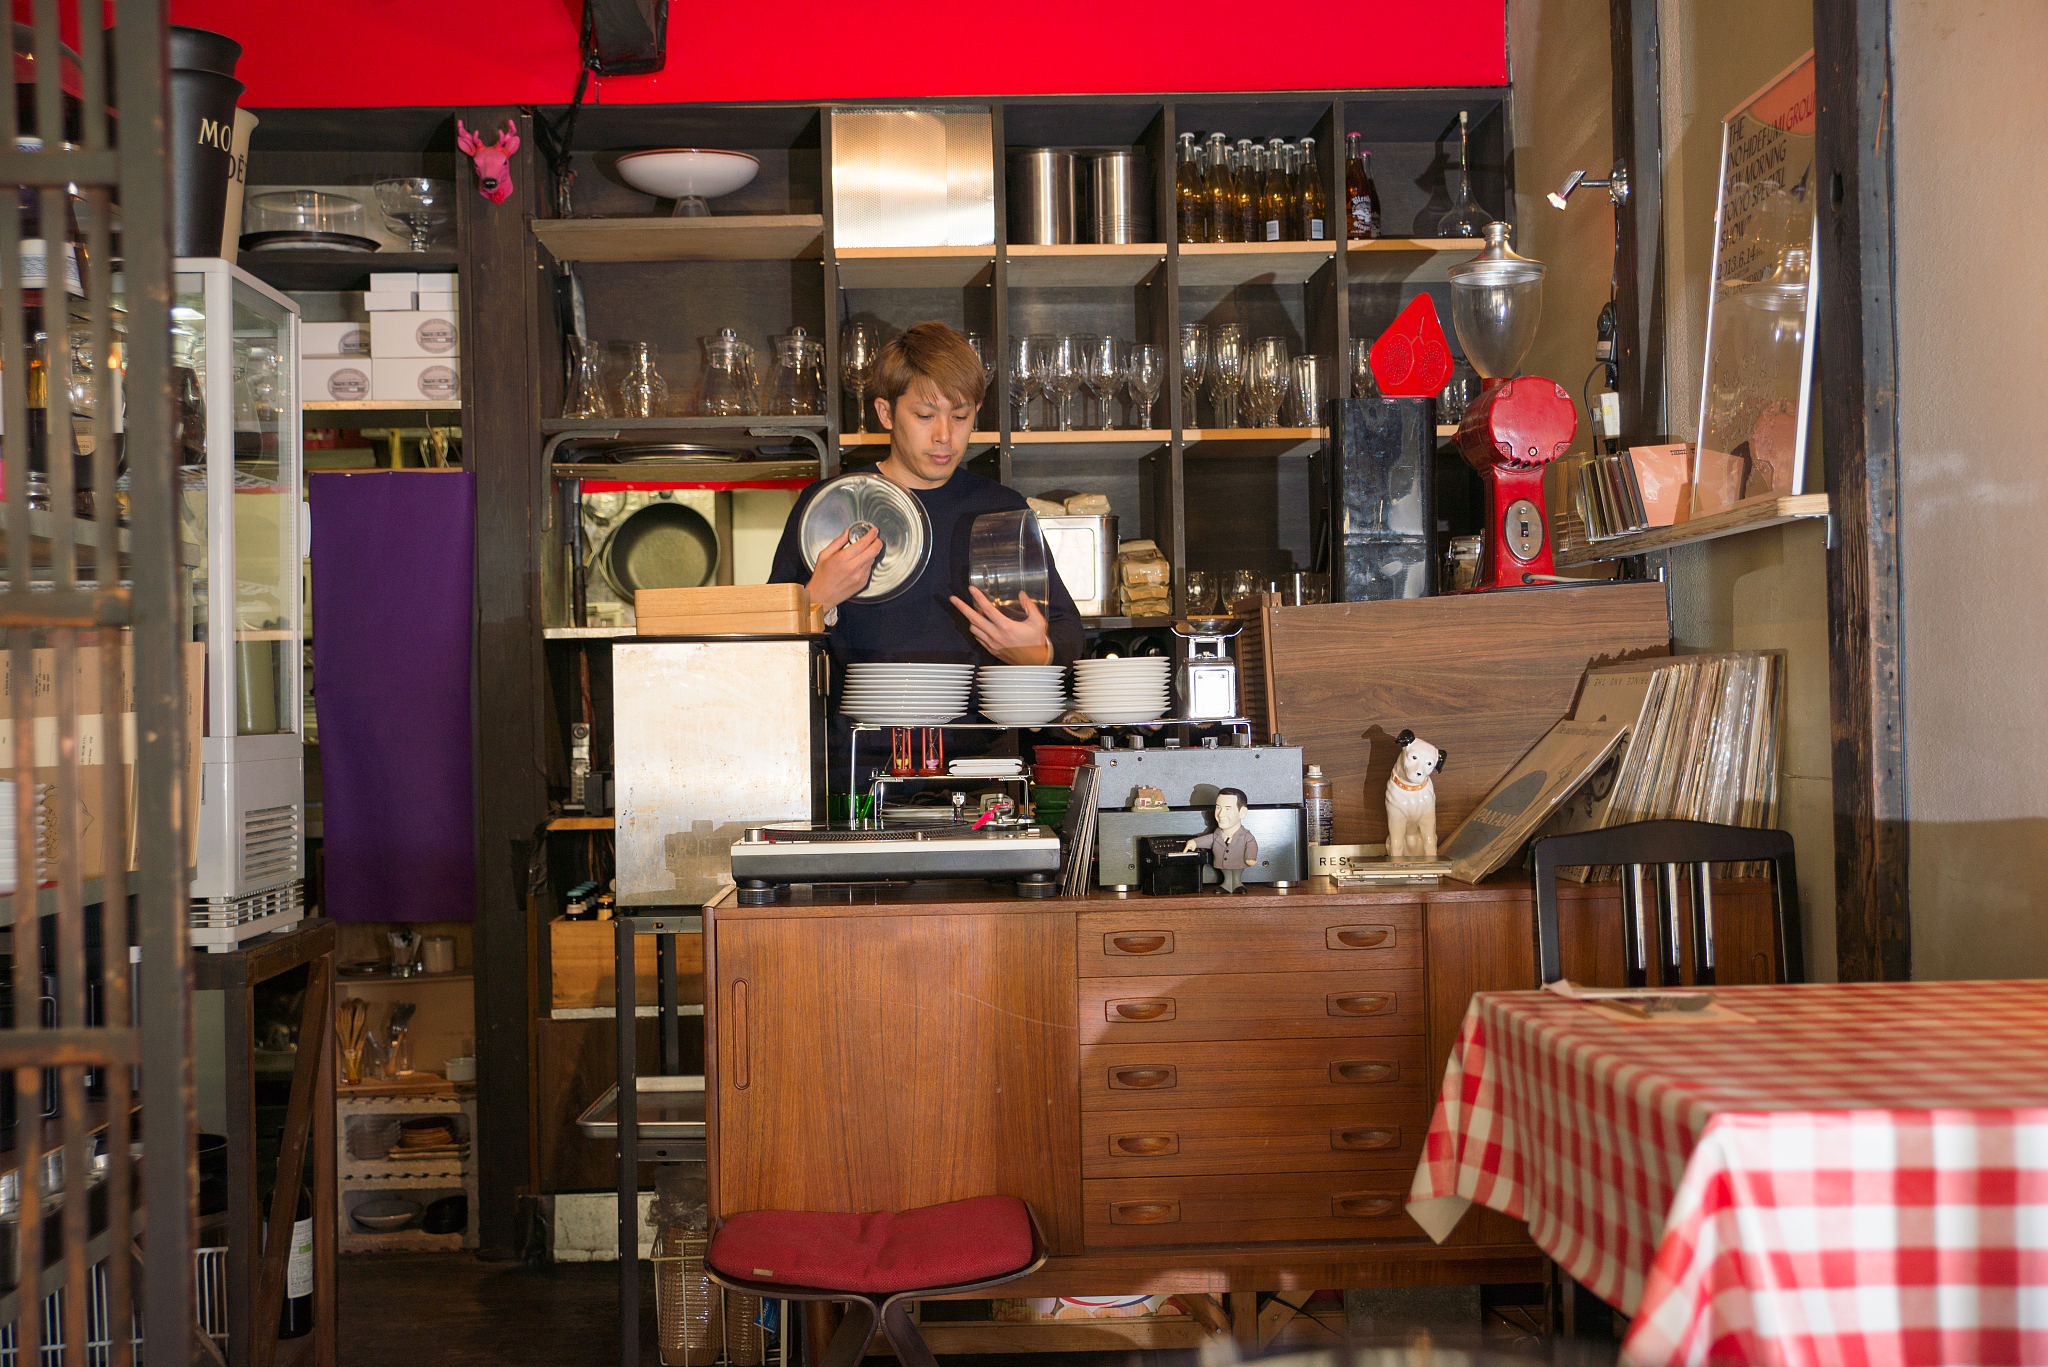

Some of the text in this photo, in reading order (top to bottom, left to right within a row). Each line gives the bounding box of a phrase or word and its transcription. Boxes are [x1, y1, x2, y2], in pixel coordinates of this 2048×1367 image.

[198, 117, 231, 152] MO
[1725, 145, 1742, 174] INO
[1743, 113, 1784, 162] HIDEFUMI
[1729, 116, 1746, 147] THE
[1746, 139, 1787, 184] MORNING
[1723, 190, 1750, 226] TOKYO
[1319, 857, 1350, 867] RES
